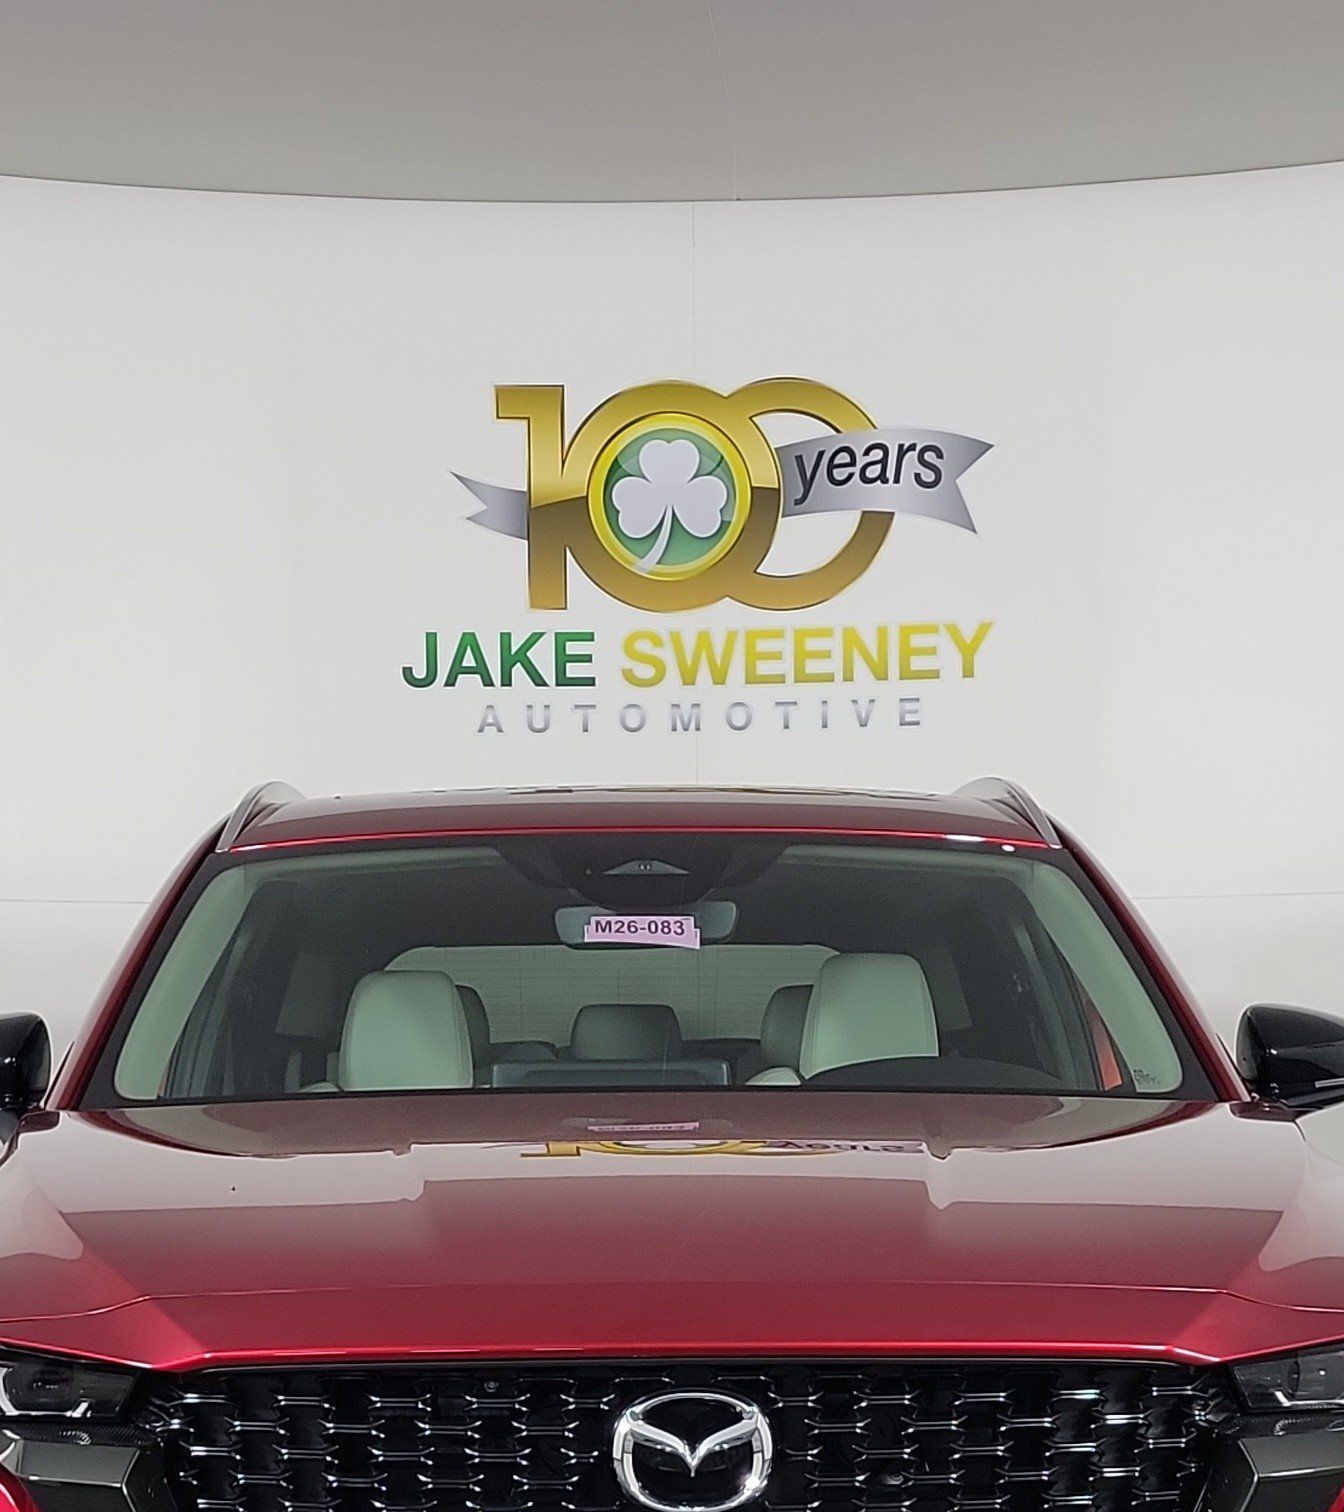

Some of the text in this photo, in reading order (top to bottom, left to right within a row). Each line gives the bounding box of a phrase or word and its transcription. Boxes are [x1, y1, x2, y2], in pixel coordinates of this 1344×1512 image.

[794, 438, 944, 507] years
[400, 620, 993, 690] JAKE SWEENEY
[477, 697, 922, 735] AUTOMOTIVE
[594, 919, 686, 936] M26-083
